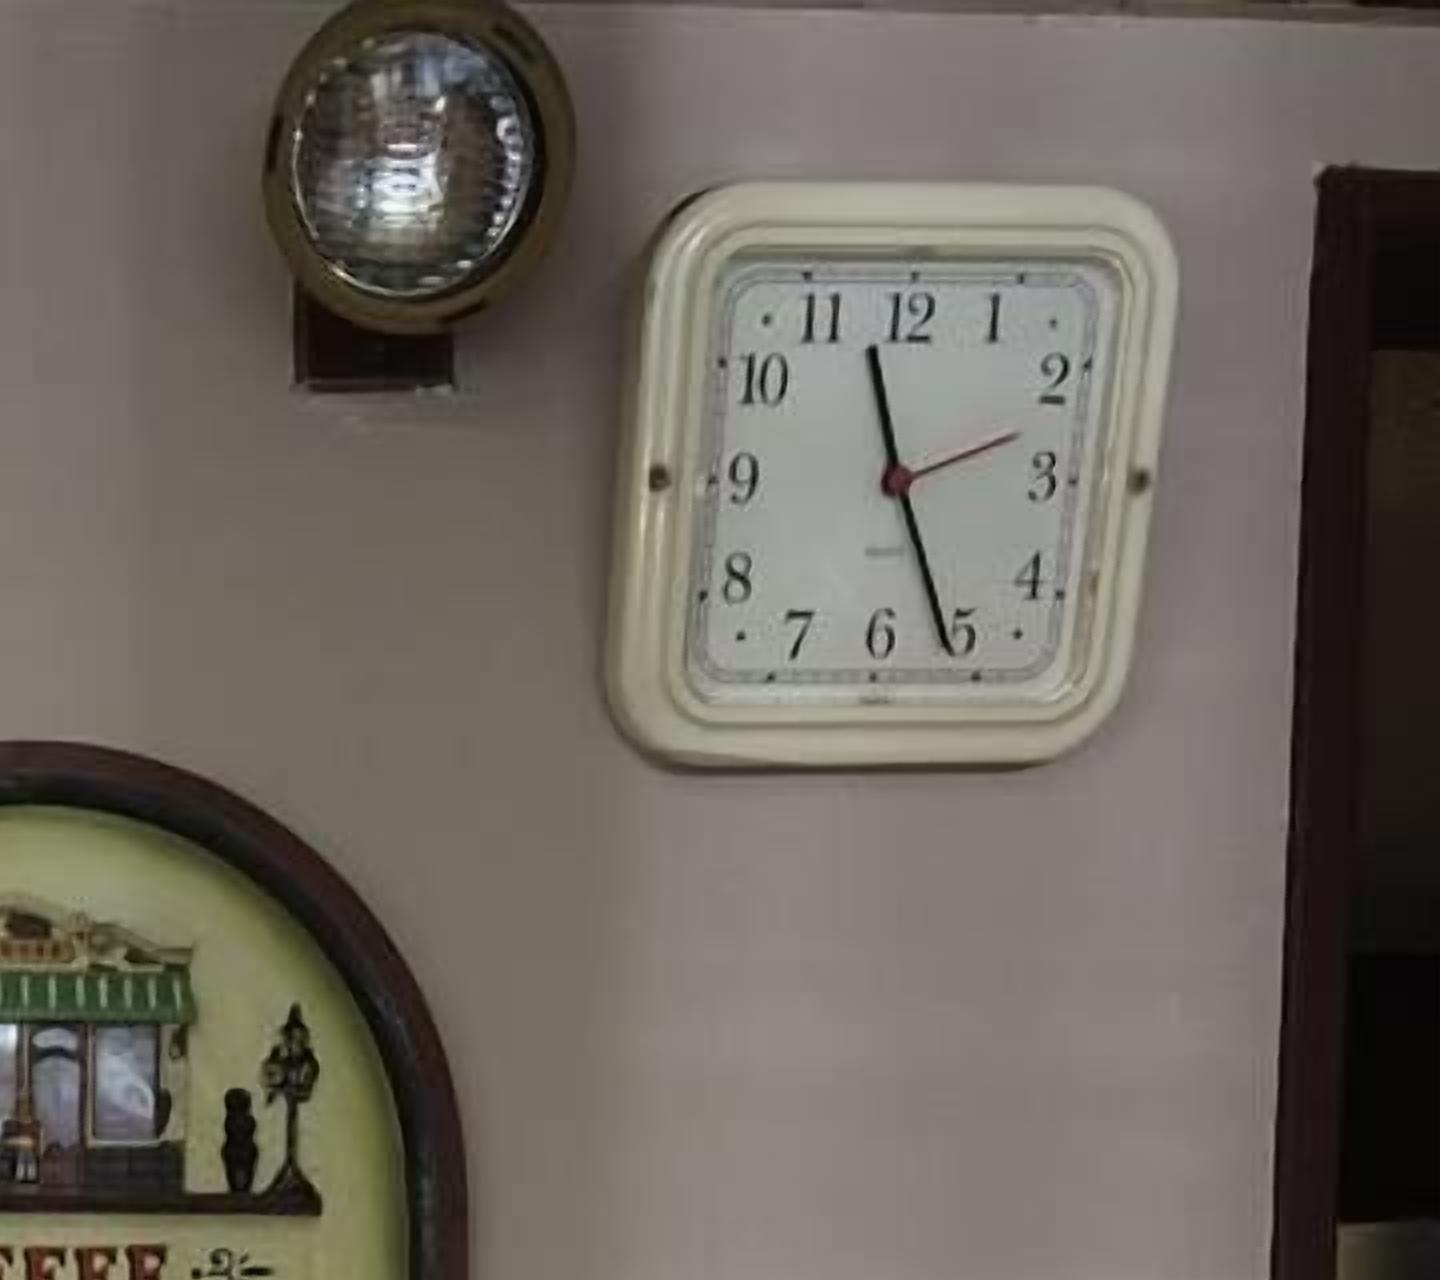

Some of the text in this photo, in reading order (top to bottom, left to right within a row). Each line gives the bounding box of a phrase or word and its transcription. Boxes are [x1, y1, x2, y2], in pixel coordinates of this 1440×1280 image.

[800, 292, 1003, 344] 11 12 1
[739, 352, 789, 407] 10
[1037, 353, 1071, 406] 2
[727, 452, 760, 506] 9
[1027, 451, 1058, 504] 3
[722, 552, 754, 604] 8
[1014, 552, 1044, 602] 4
[784, 609, 816, 660] 7
[865, 609, 896, 659] 6
[949, 608, 978, 656] 5
